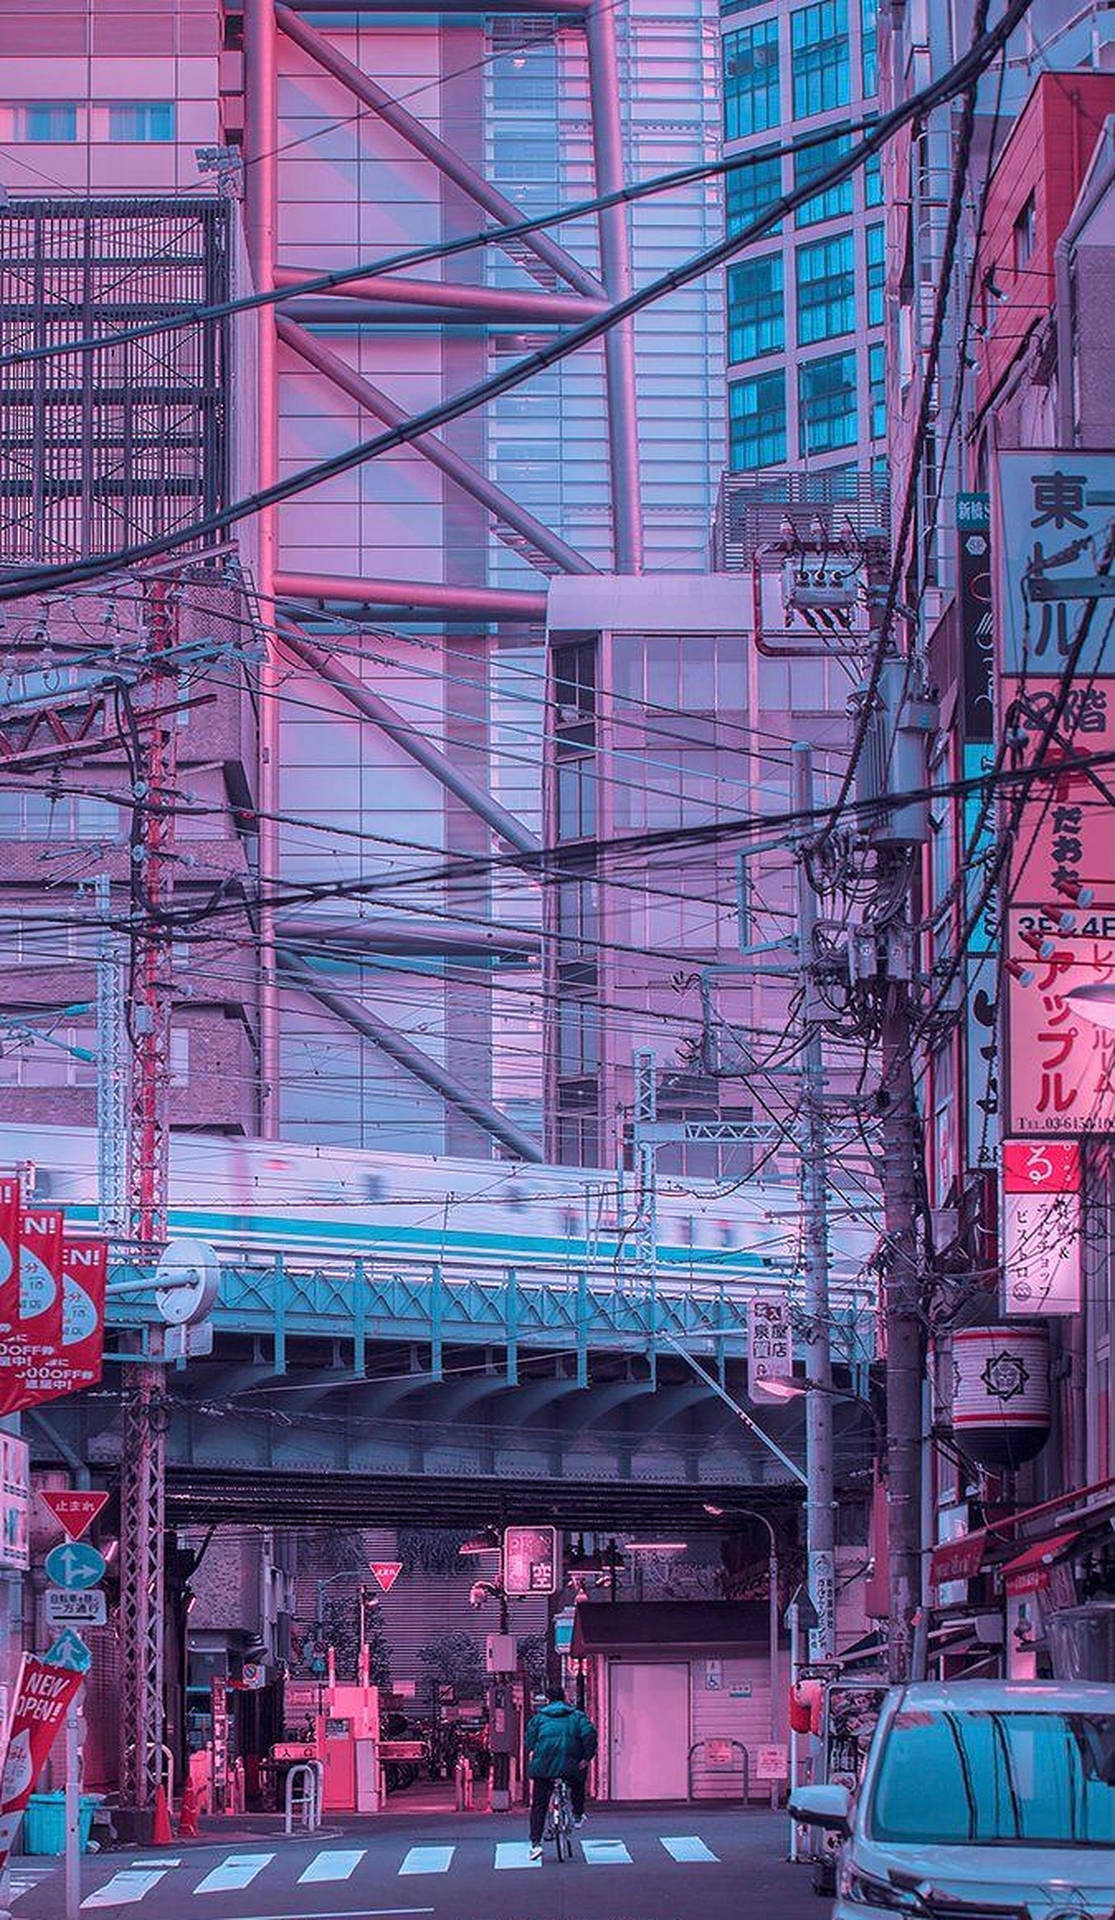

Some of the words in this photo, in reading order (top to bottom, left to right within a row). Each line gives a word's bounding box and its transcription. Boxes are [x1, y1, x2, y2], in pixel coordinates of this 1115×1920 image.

[1035, 951, 1077, 1112] アップル
[55, 1501, 94, 1512] 止まれ
[532, 1562, 552, 1588] 空
[50, 1602, 99, 1614] 一方通行
[26, 1672, 70, 1698] NEW
